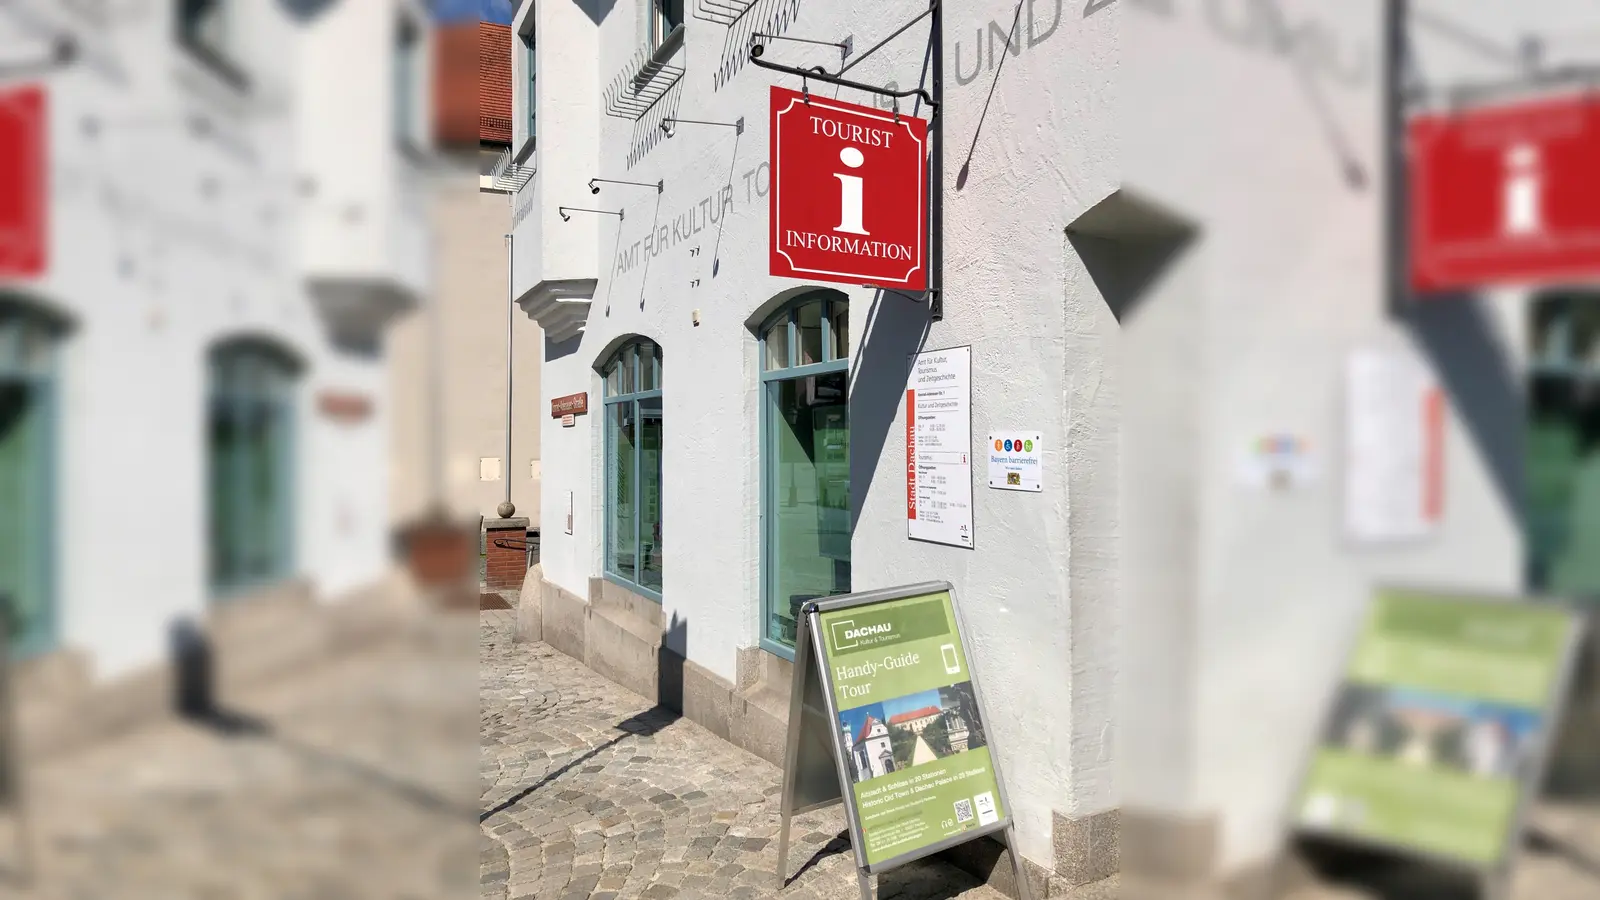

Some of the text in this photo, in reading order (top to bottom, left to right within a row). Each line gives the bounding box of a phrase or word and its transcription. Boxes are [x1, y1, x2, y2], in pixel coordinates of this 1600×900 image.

[809, 116, 894, 149] TOURIST
[832, 146, 871, 236] i
[616, 161, 770, 278] AMT FÜR KULTUR TO
[785, 229, 912, 261] INFORMATION
[926, 373, 956, 383] Zeitgeschichte
[990, 455, 1009, 465] Bayern
[908, 478, 916, 510] Stadt
[845, 622, 892, 640] DACHAU
[859, 638, 874, 646] Kultur
[878, 633, 901, 643] Tourismus
[835, 652, 920, 681] Handy-Guide
[839, 682, 872, 700] Tour
